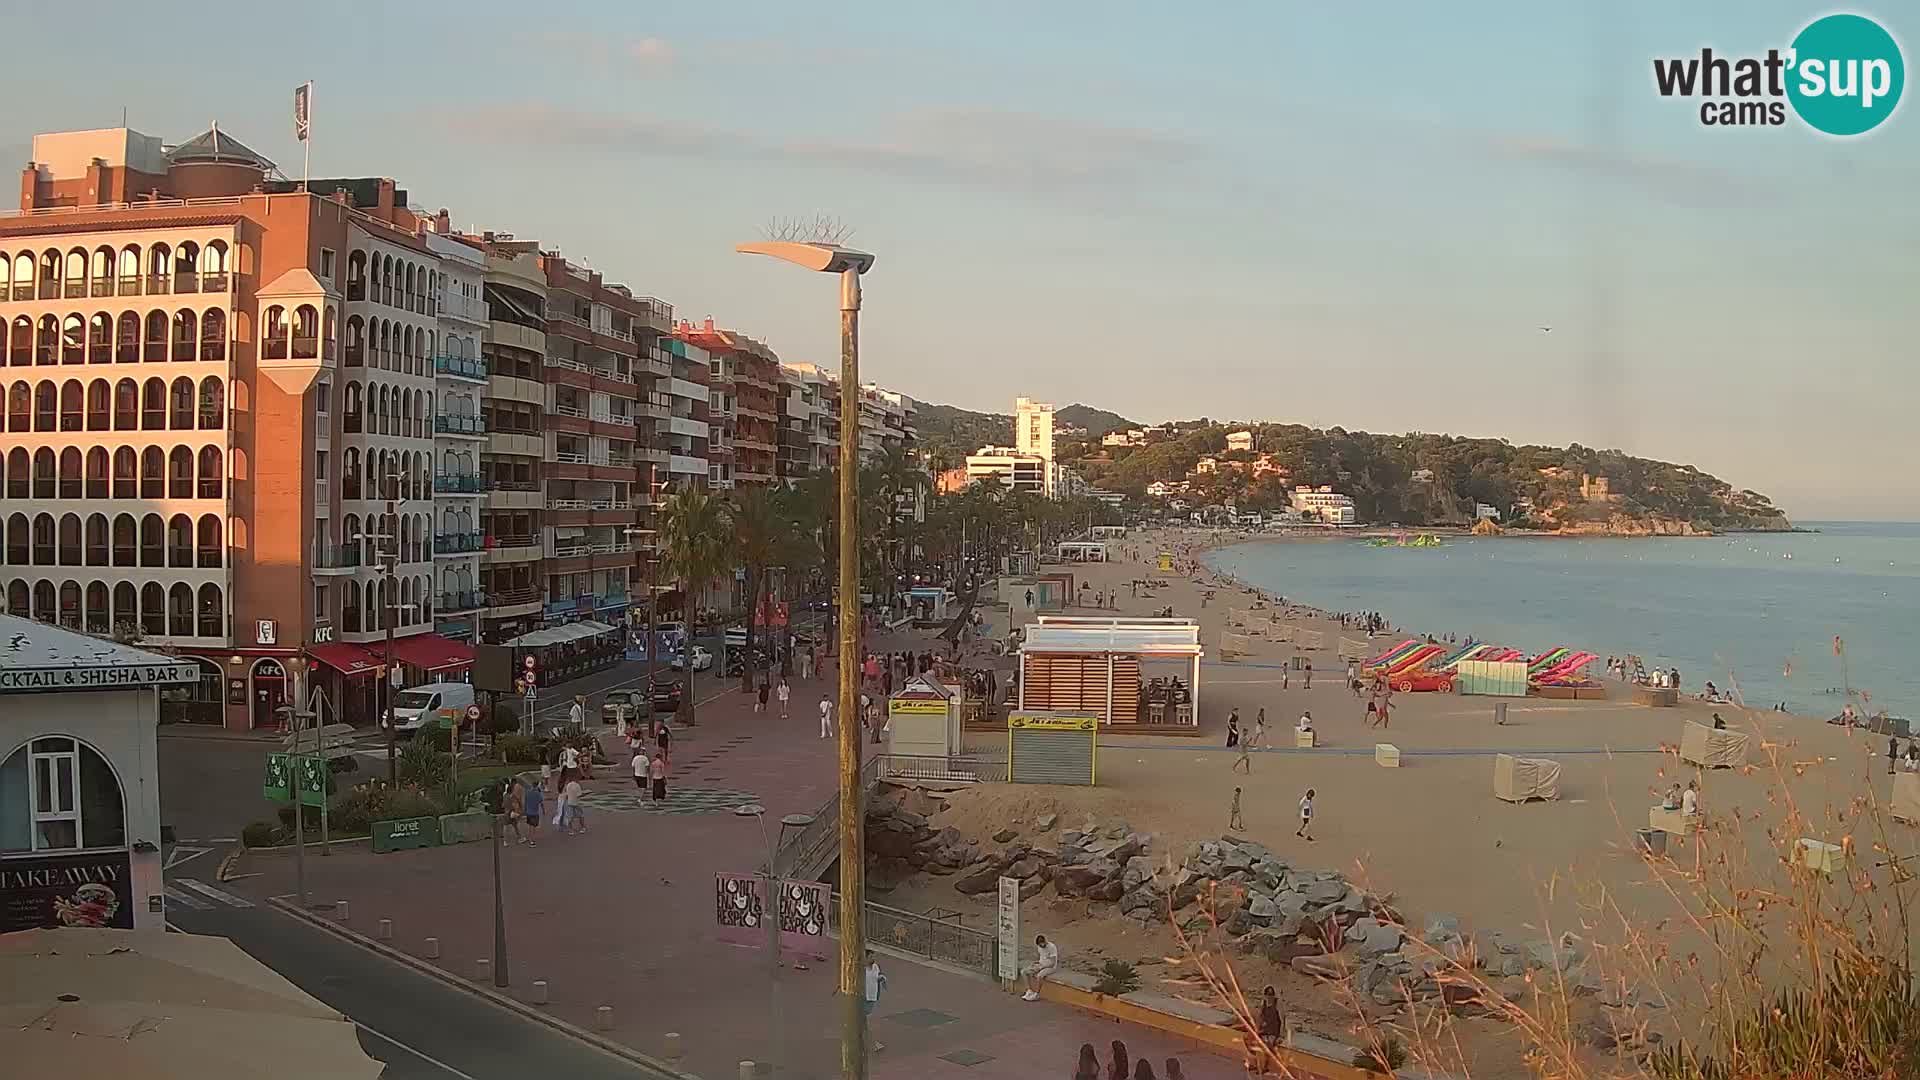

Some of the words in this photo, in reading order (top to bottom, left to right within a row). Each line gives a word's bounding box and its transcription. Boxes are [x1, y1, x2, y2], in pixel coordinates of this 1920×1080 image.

[314, 626, 333, 643] KFC
[64, 670, 75, 684] &
[80, 668, 141, 683] SHISHA
[145, 667, 179, 681] BAR
[258, 665, 282, 676] KFC
[0, 864, 121, 888] TAKEAWAY
